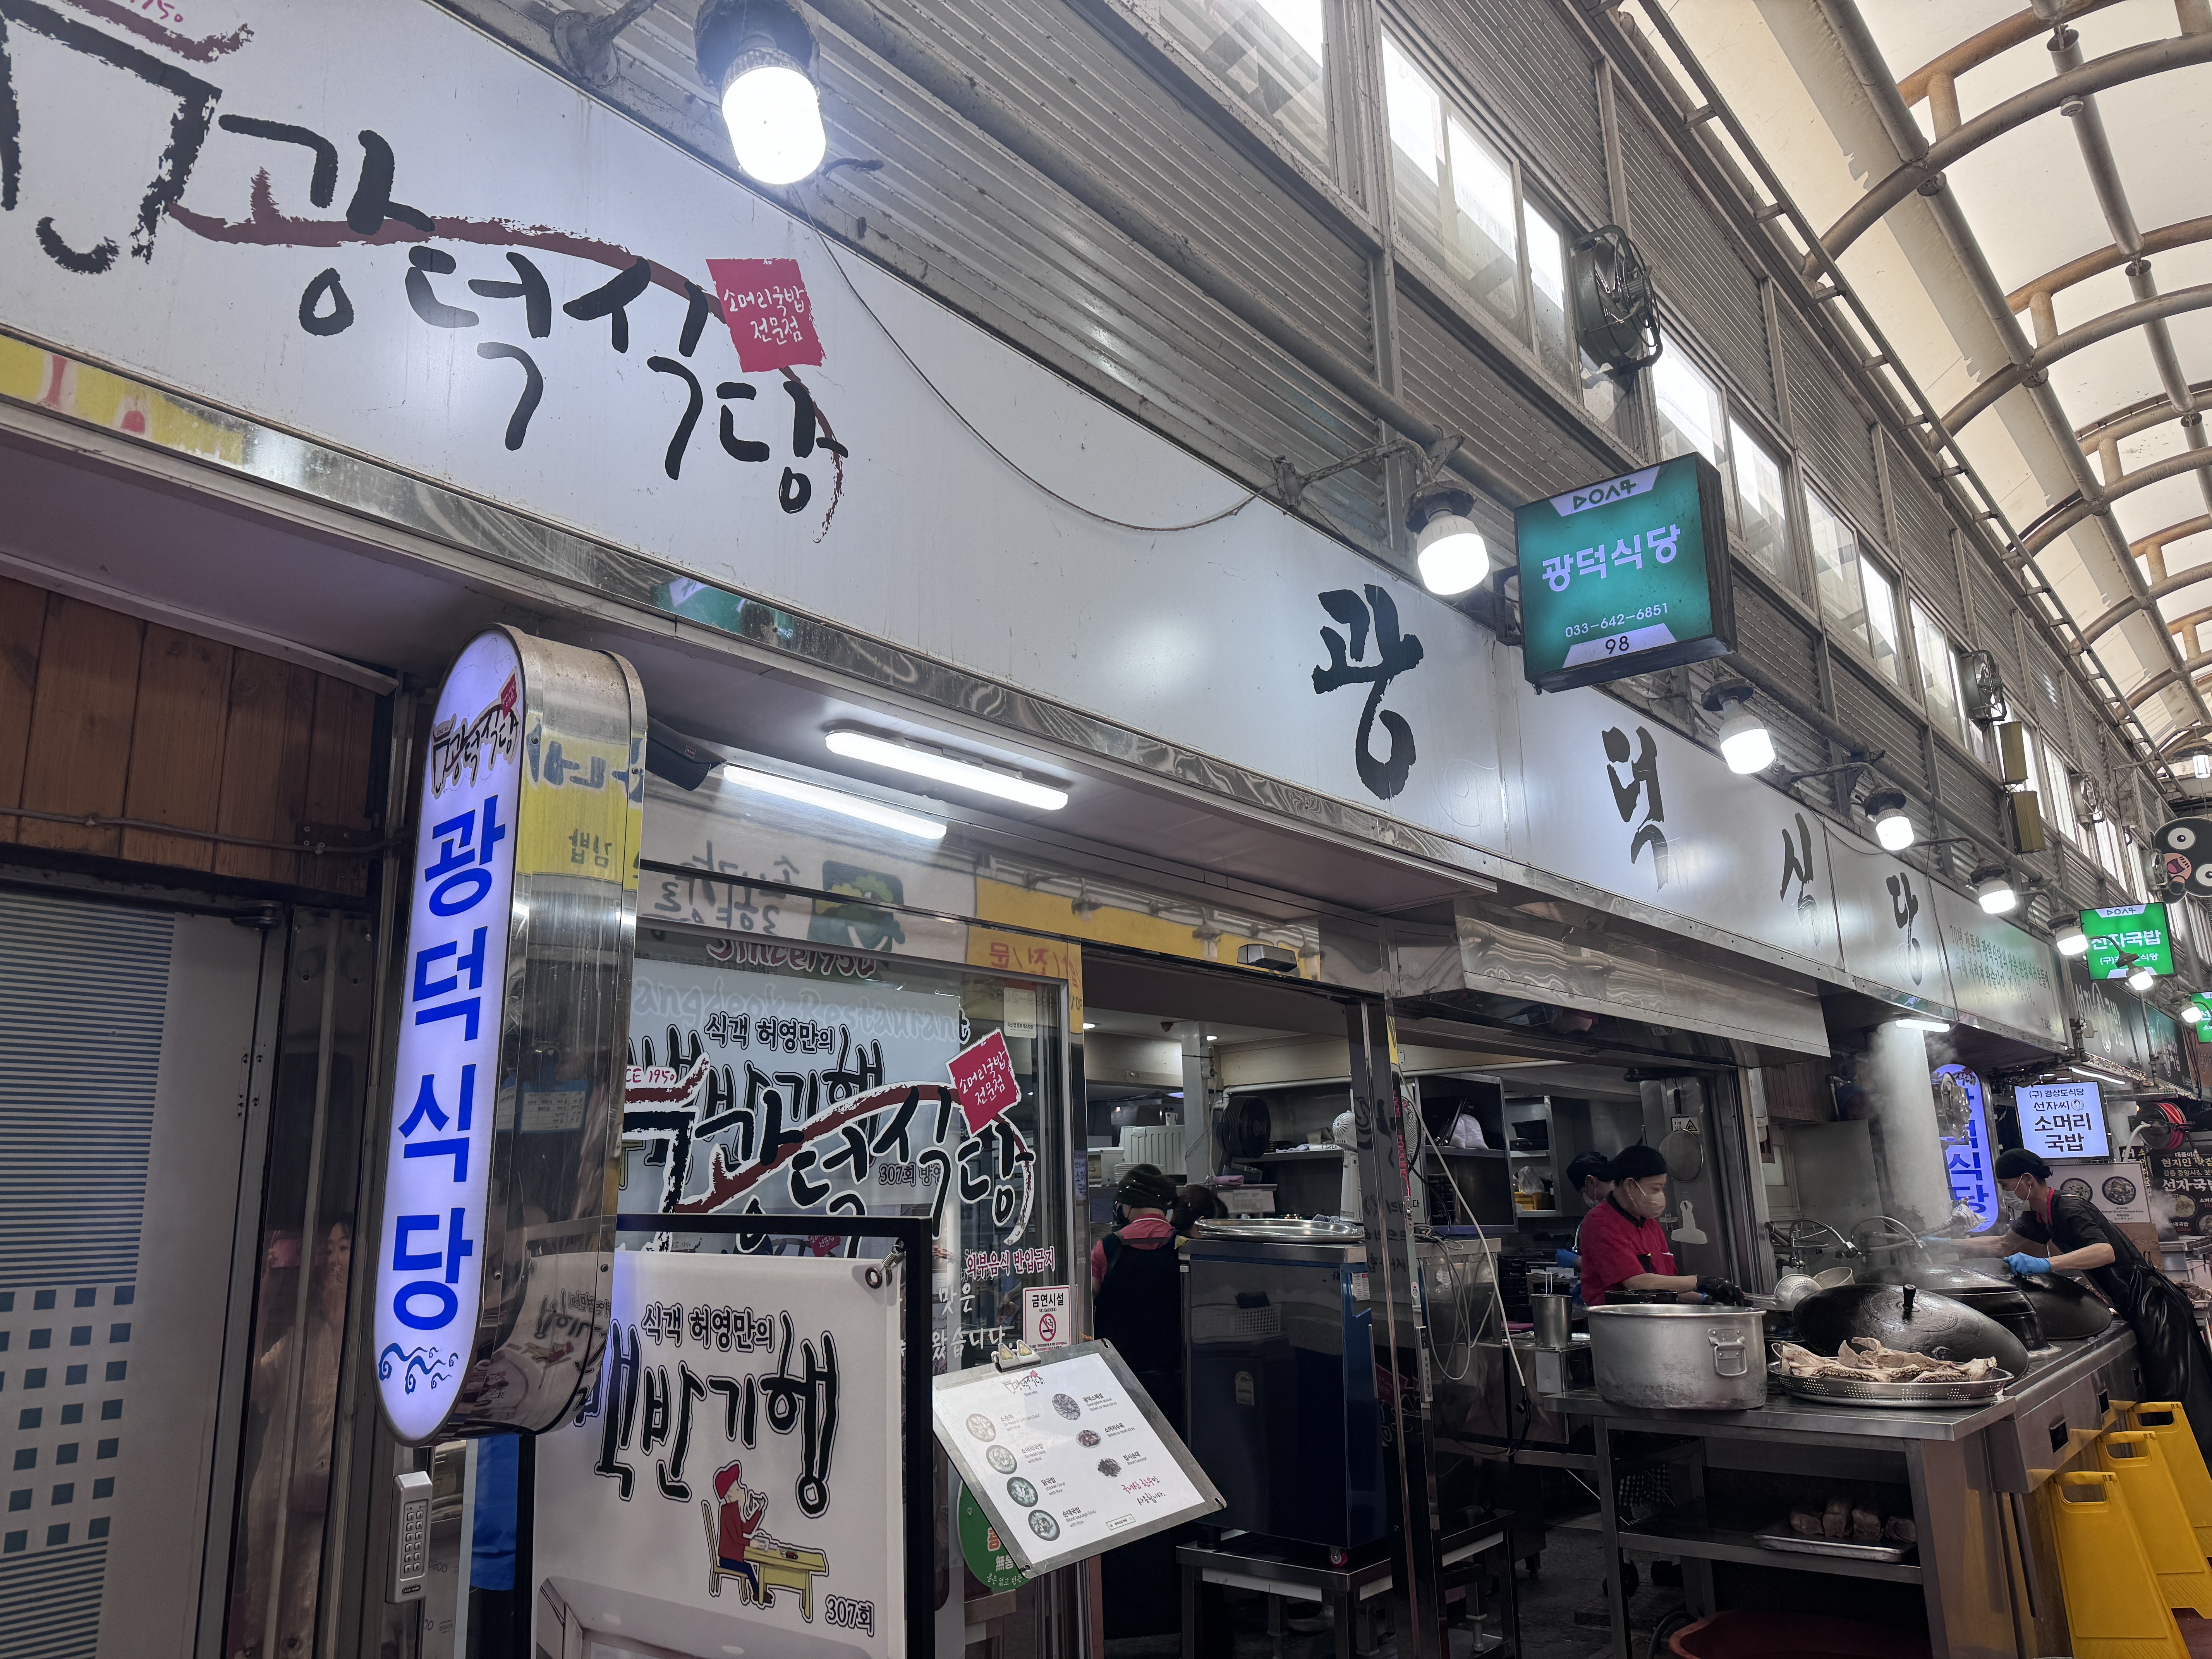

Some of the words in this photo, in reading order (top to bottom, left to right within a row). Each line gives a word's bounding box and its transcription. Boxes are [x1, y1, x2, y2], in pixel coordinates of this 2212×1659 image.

[723, 285, 804, 317] 소머리국밥
[194, 113, 848, 514] 광덕식당
[750, 316, 803, 345] 전문점
[1542, 524, 1681, 592] 광덕식당
[1565, 603, 1668, 638] 033-642-6851
[1605, 635, 1630, 654] 98
[446, 709, 519, 782] 광덕식당
[1950, 924, 1965, 950] 70년
[1964, 931, 1982, 960] 전통의
[2091, 930, 2161, 950] 선자국밥
[2100, 953, 2159, 965] (구)식당
[705, 1012, 750, 1049] 식객
[756, 1016, 835, 1055] 허영만의
[392, 794, 505, 1330] 광덕식당
[959, 1051, 1005, 1094] 소머리국밥
[649, 1069, 675, 1084] 1950
[975, 1074, 1006, 1105] 전문점
[2044, 1088, 2084, 1097] 경상도식당
[2034, 1101, 2069, 1112] 선자씨
[2034, 1113, 2092, 1132] 소머리
[2045, 1133, 2085, 1152] 국밥
[689, 1086, 1036, 1257] 광덕식당
[2161, 1158, 2191, 1168] 현지인
[878, 1163, 916, 1187] 307회
[966, 1250, 1010, 1280] 외부음식
[1012, 1245, 1056, 1274] 반입금지
[939, 1283, 976, 1316] 맛은
[1031, 1292, 1064, 1308] 금연시설
[641, 1302, 684, 1346] 식객
[688, 1306, 775, 1352] 허영만의
[1104, 1423, 1125, 1433] 소머리수육
[1021, 1443, 1044, 1454] 소머리국밥
[1123, 1451, 1141, 1461] 접시순대
[1041, 1476, 1056, 1486] 닭국밥
[1121, 1481, 1141, 1494] 국내산
[1139, 1476, 1160, 1488] 한우만
[1137, 1491, 1166, 1506] 사용합니다.
[1062, 1506, 1082, 1518] 순대국밥
[825, 1595, 875, 1637] 307회
